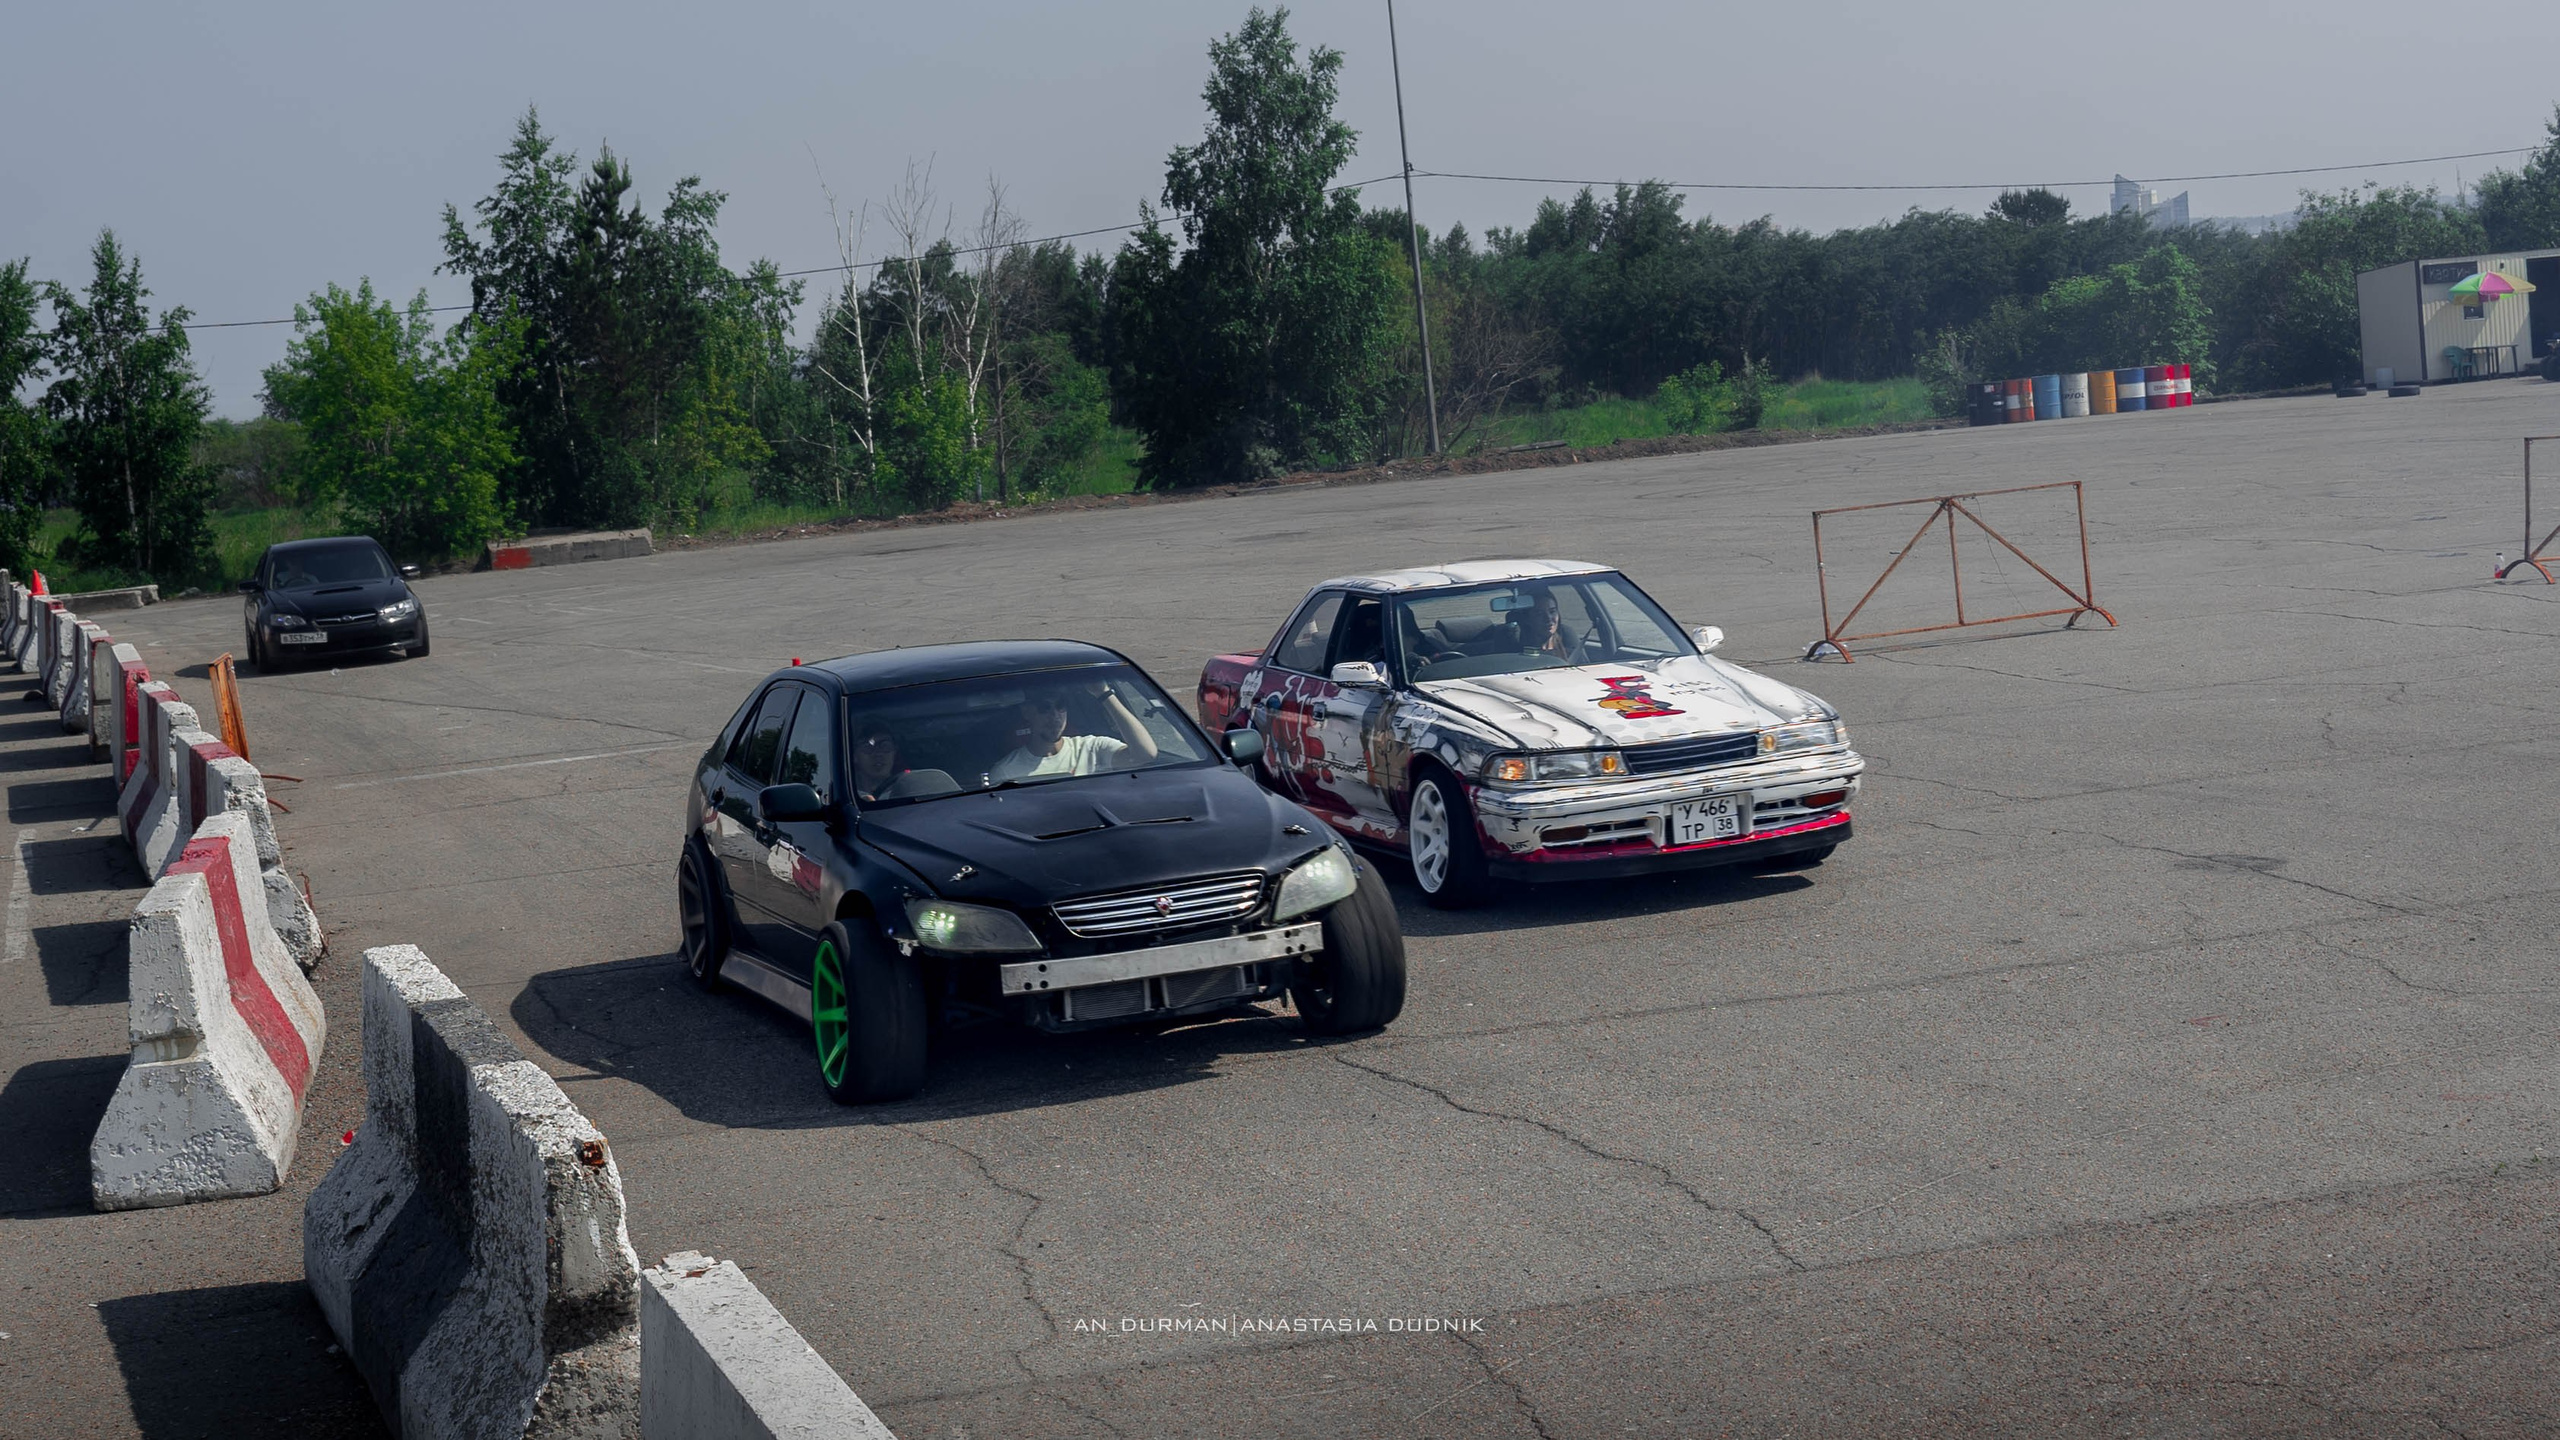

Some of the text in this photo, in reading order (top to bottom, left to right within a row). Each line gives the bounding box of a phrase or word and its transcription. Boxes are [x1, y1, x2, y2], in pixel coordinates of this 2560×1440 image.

[2062, 391, 2085, 400] PSOL
[1698, 798, 1728, 817] 466
[1681, 817, 1734, 840] ТР 38
